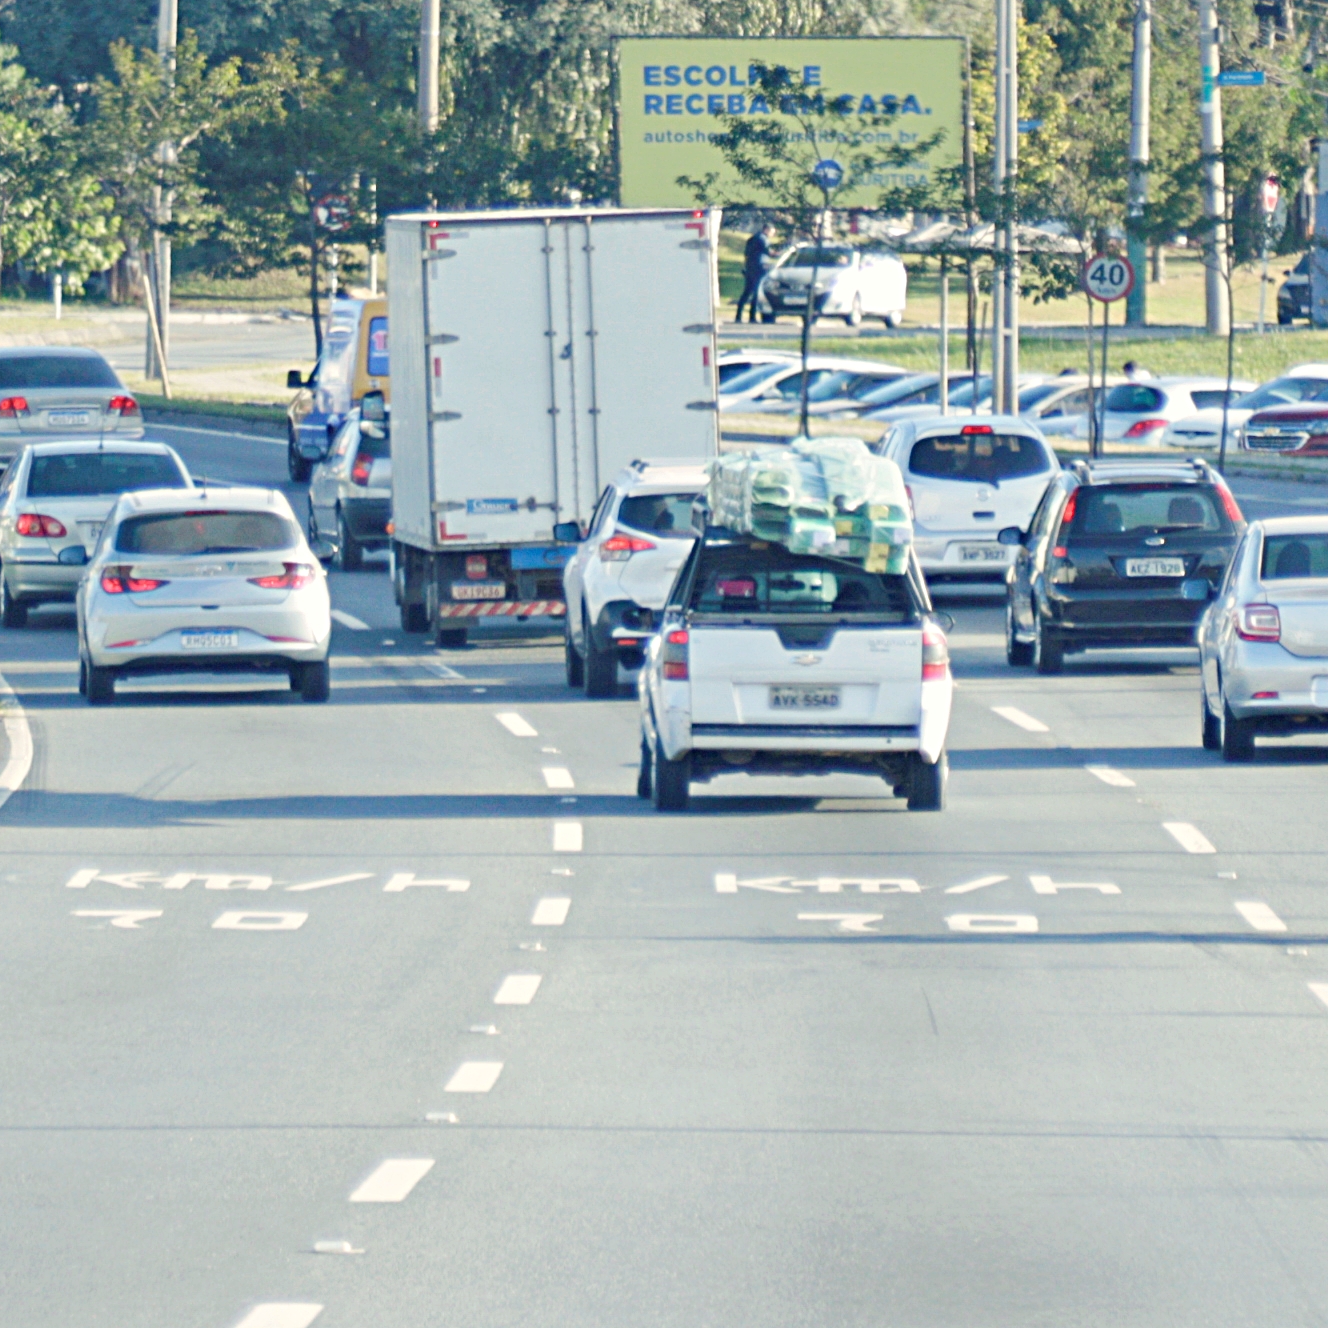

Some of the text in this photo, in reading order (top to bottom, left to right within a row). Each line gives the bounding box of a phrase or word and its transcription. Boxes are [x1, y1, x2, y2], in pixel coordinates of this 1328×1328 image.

[803, 65, 822, 86] E
[643, 93, 770, 115] RECEBA
[850, 173, 929, 188] URITIBA
[1090, 263, 1124, 286] 40
[70, 909, 309, 930] 70
[796, 912, 1039, 933] 70
